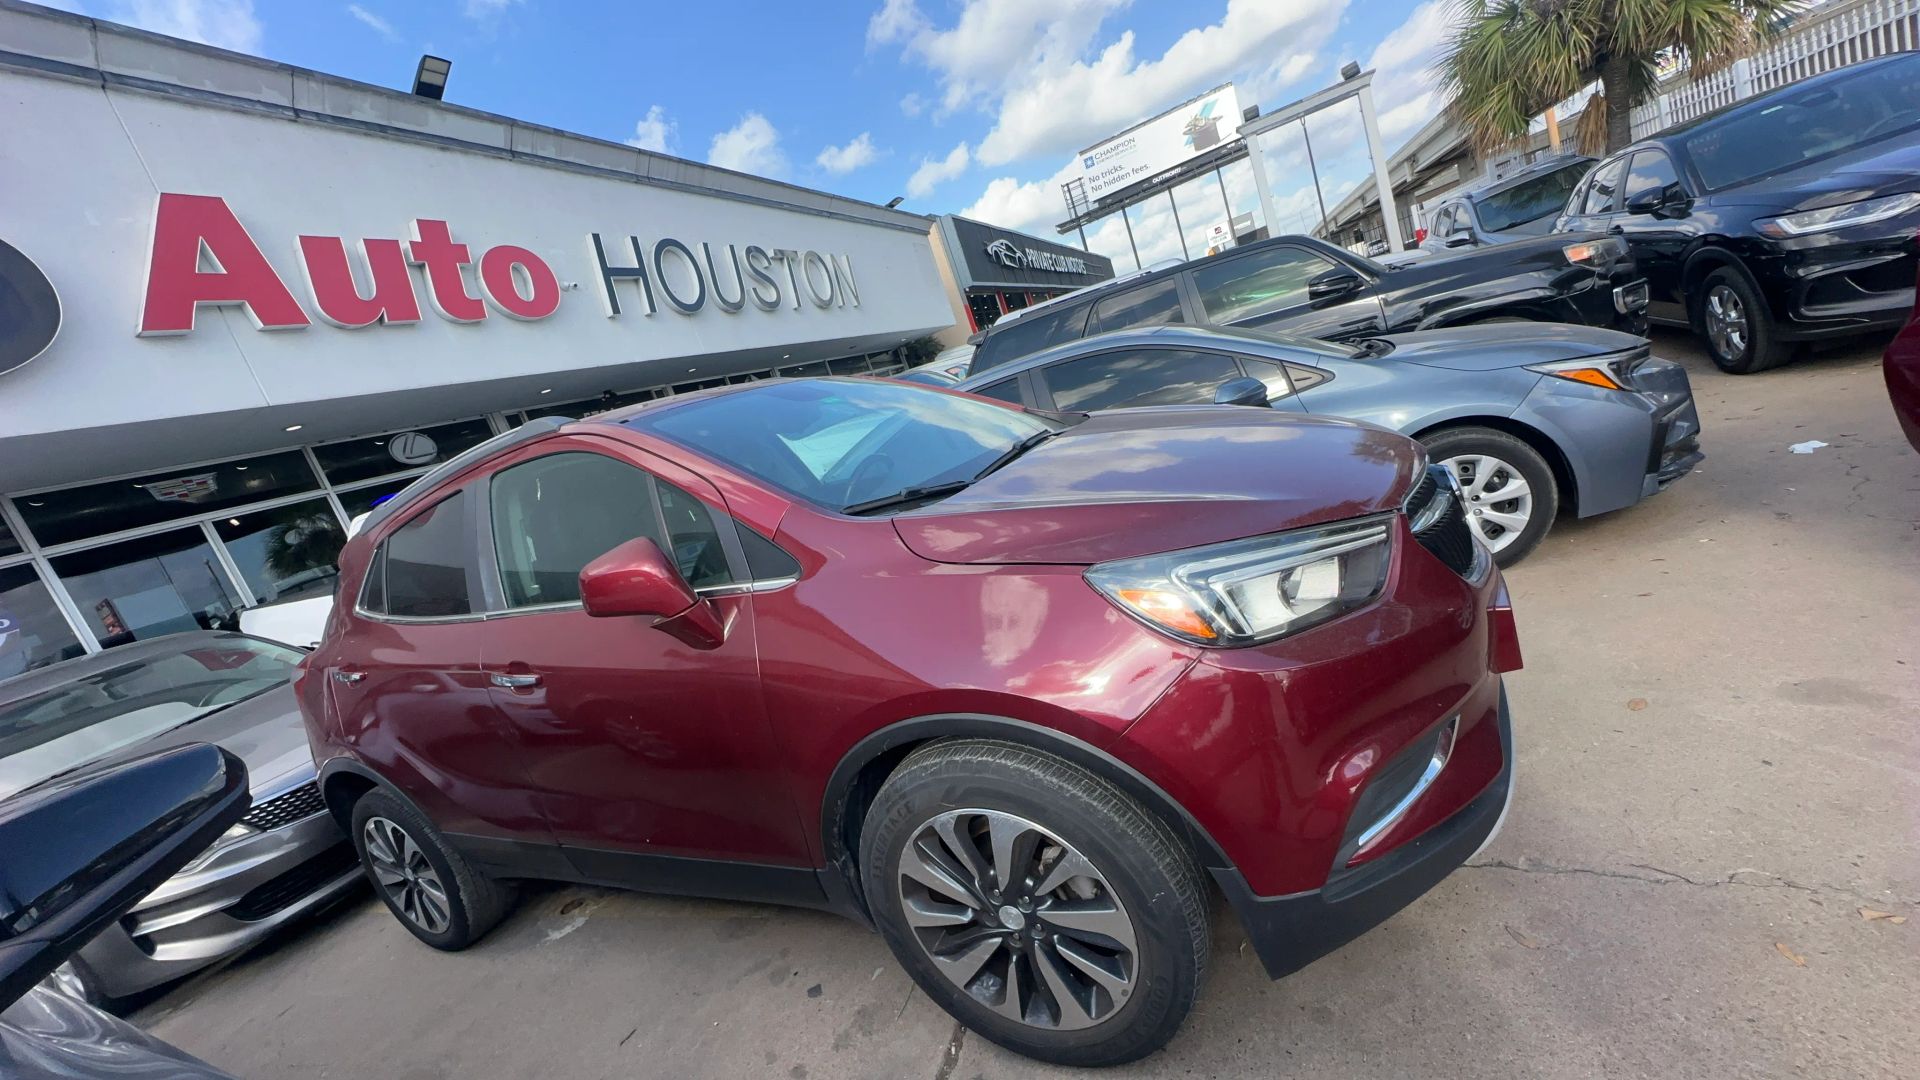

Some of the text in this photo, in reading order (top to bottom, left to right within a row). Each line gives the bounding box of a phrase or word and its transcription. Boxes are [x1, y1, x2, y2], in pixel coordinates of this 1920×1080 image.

[1094, 137, 1136, 160] CHAMPION
[1089, 164, 1125, 183] No tricks.
[1091, 163, 1151, 193] No hidden fees.
[135, 192, 861, 337] Auto HOUSTON
[1025, 248, 1055, 272] PRIVATE
